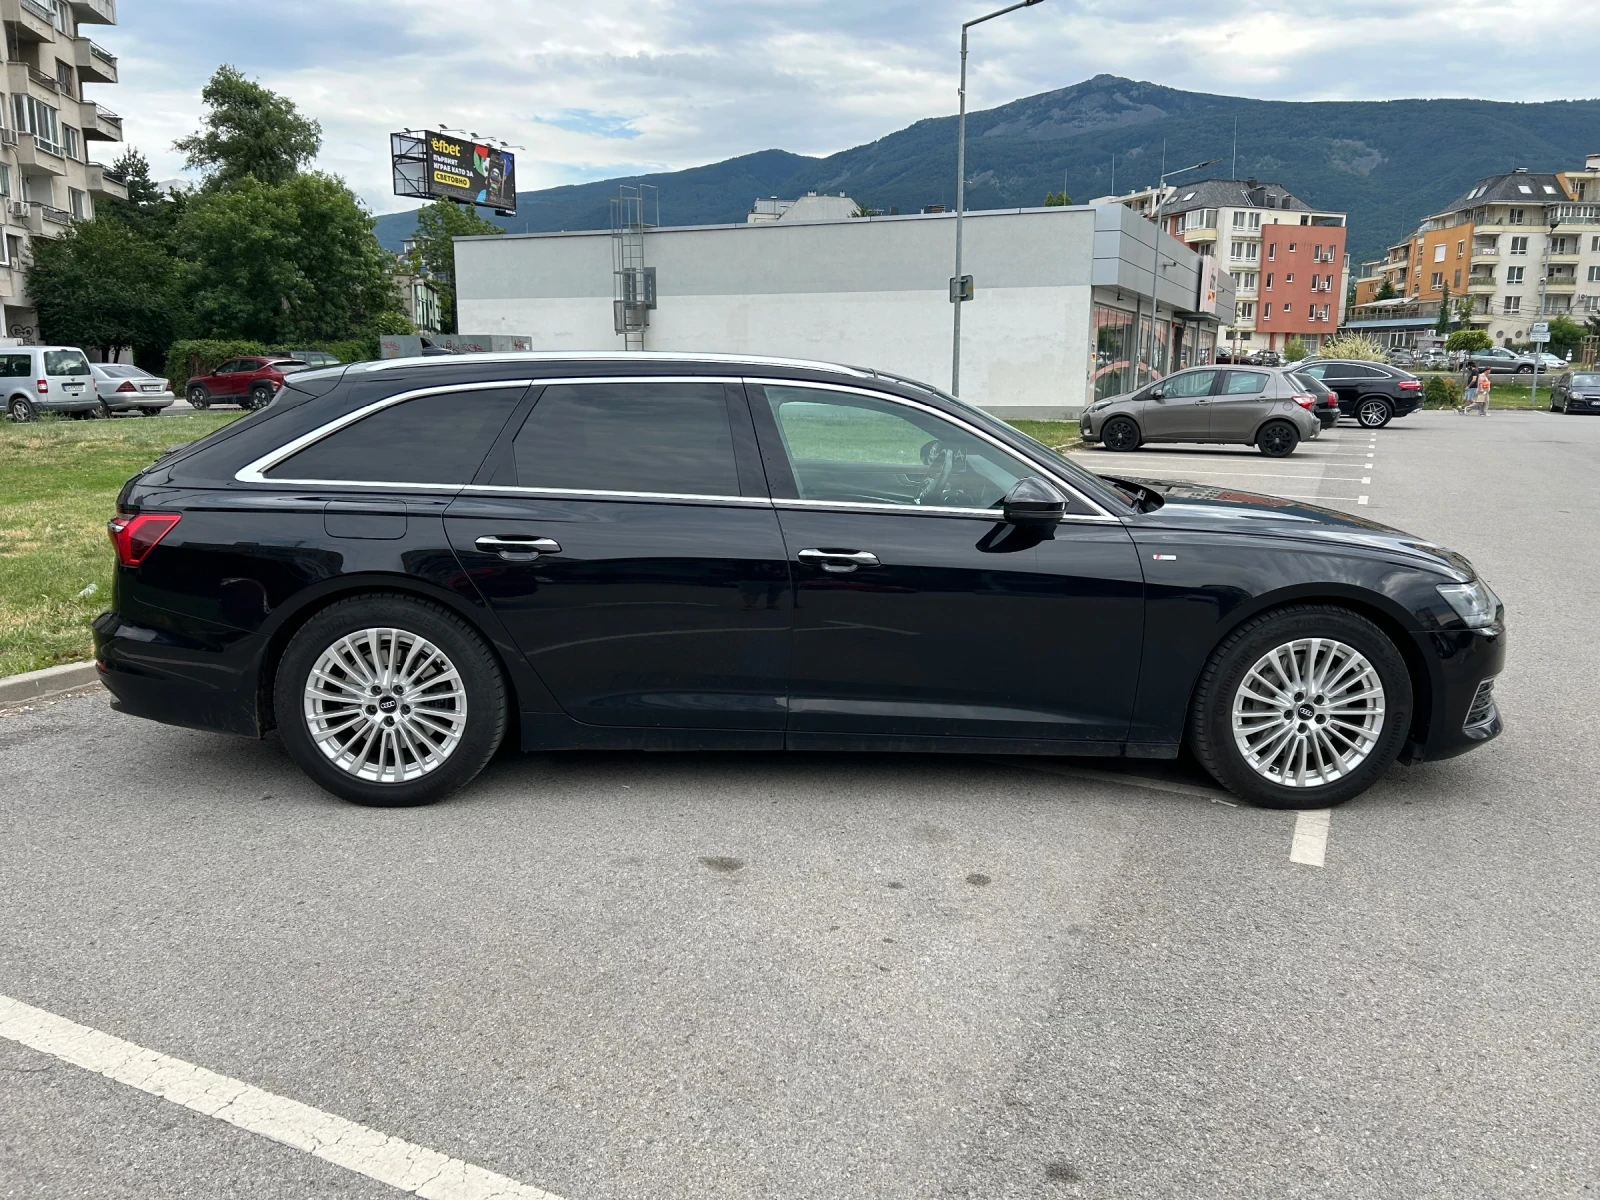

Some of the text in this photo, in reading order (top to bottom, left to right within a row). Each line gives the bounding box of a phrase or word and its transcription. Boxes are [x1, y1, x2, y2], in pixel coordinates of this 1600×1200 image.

[432, 139, 461, 157] efbet
[432, 154, 458, 166] ПЪРВИЯТ
[433, 162, 474, 178] ИГРАЕ КАТО ЗА
[436, 172, 468, 186] СВЕТОВНО
[1213, 649, 1253, 717] Continental
[1368, 711, 1405, 776] Continental
